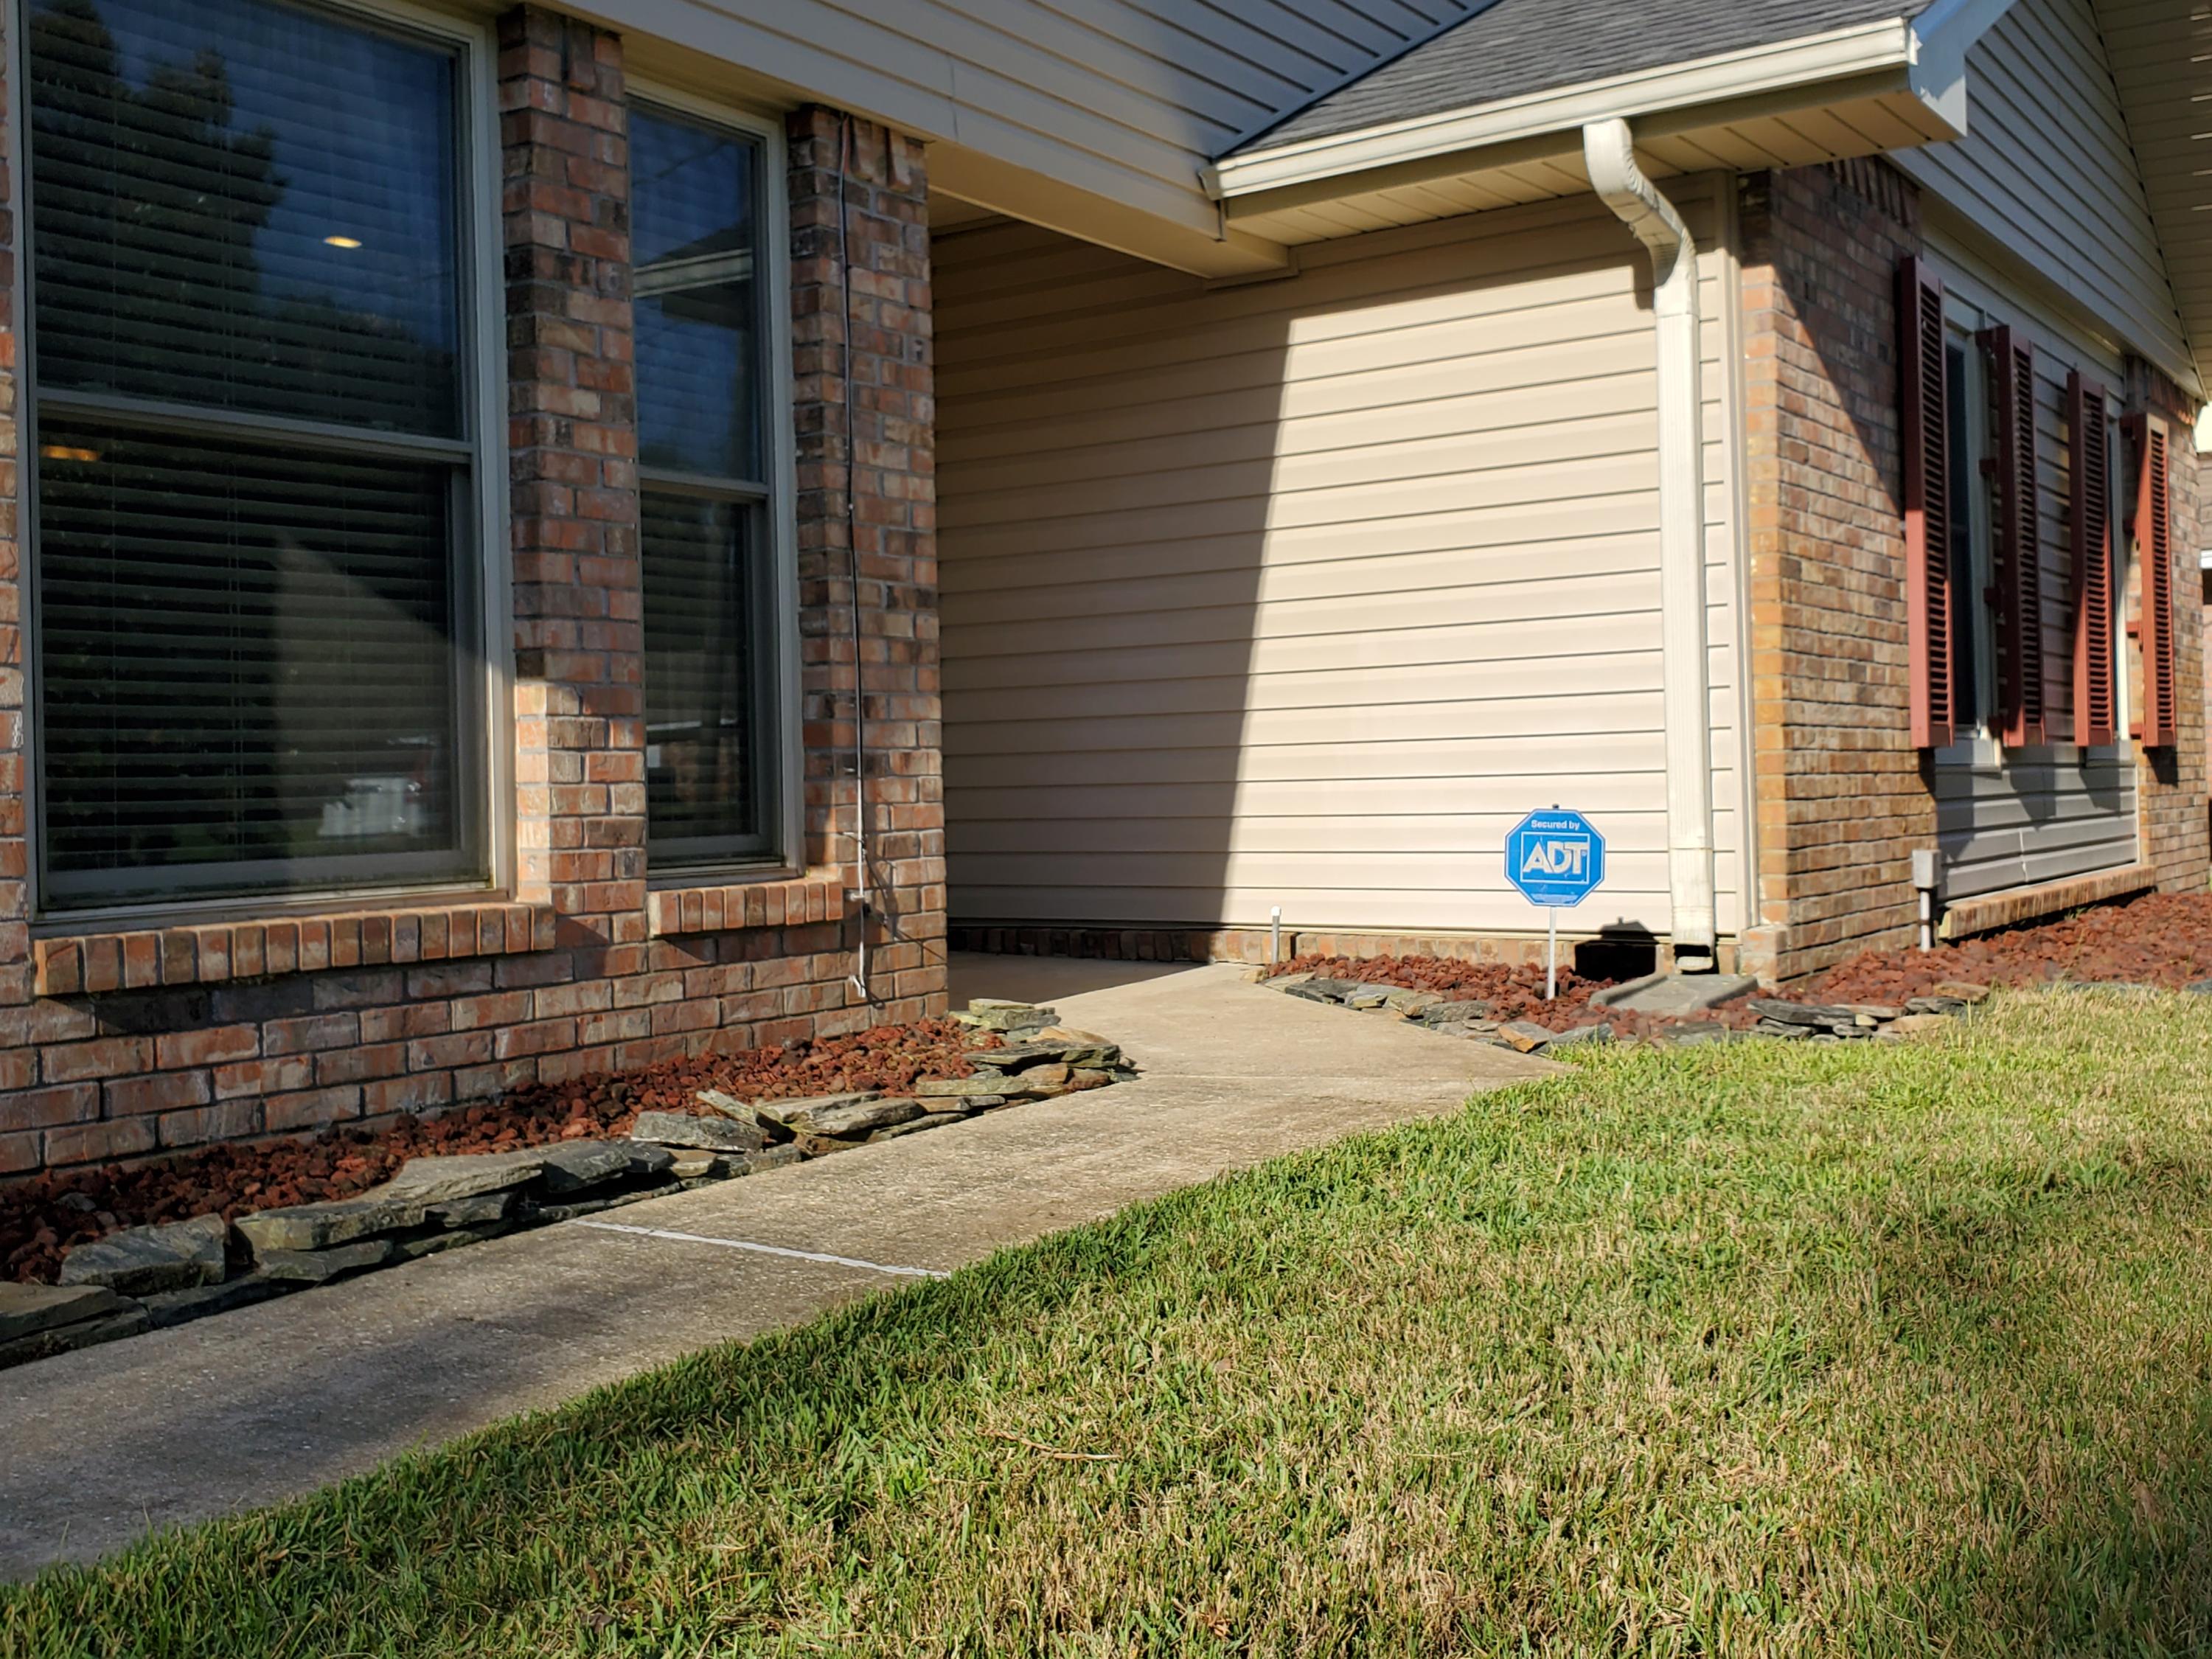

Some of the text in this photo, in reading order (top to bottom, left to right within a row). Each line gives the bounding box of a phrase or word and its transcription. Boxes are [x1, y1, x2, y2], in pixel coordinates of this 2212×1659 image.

[1531, 820, 1579, 830] Secured by
[1523, 841, 1589, 874] ADT
